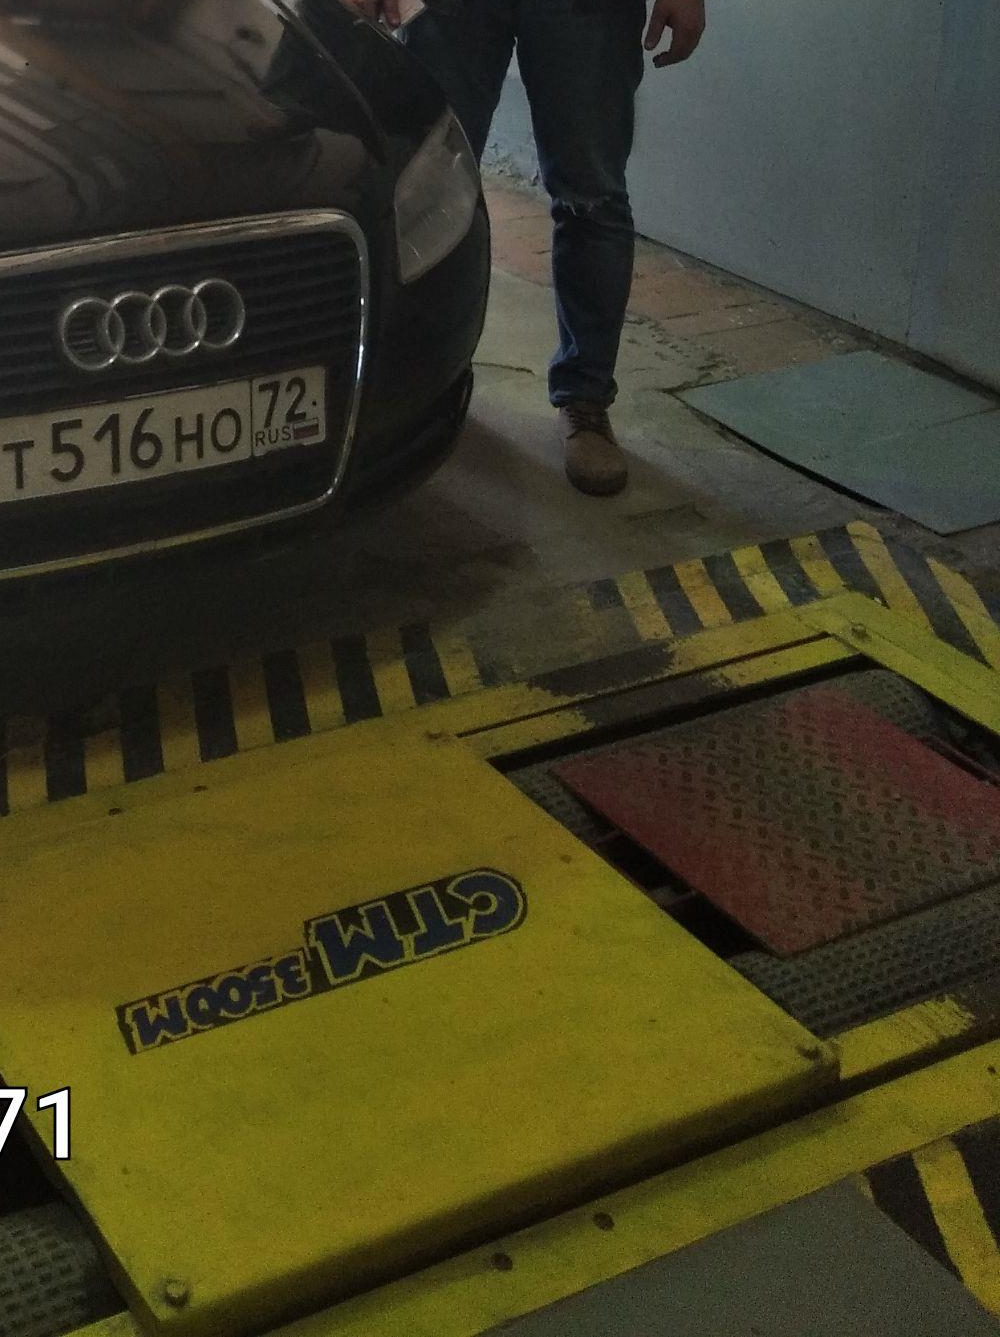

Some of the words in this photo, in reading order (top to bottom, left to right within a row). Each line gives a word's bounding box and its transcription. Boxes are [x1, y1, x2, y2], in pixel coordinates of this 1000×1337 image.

[3, 407, 242, 489] Т516НО
[258, 377, 306, 431] 72
[254, 426, 292, 446] RUS
[308, 868, 527, 985] СТМ
